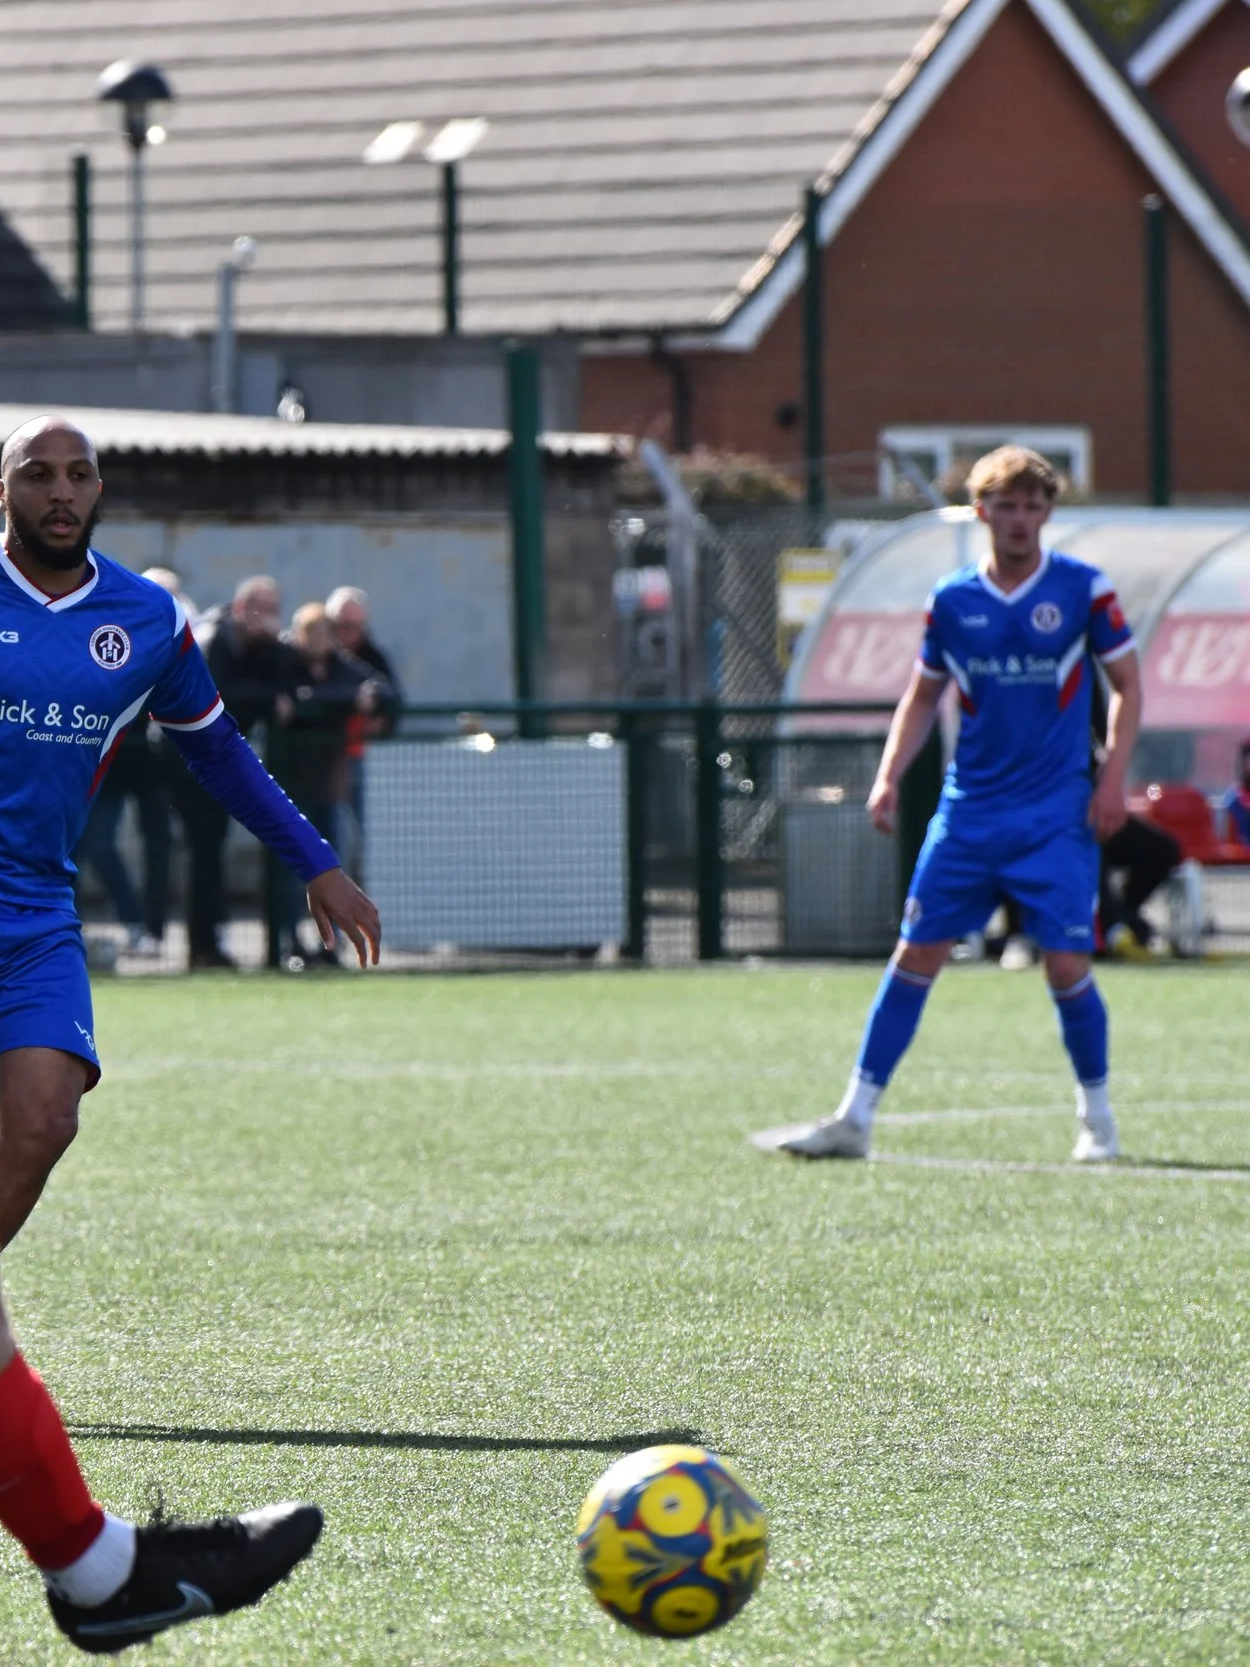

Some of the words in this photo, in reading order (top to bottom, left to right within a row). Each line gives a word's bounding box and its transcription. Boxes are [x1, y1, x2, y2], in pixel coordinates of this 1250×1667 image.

[44, 703, 63, 727] &
[71, 704, 109, 731] Son
[26, 729, 54, 742] Coast
[55, 733, 73, 744] and
[75, 733, 102, 747] Country
